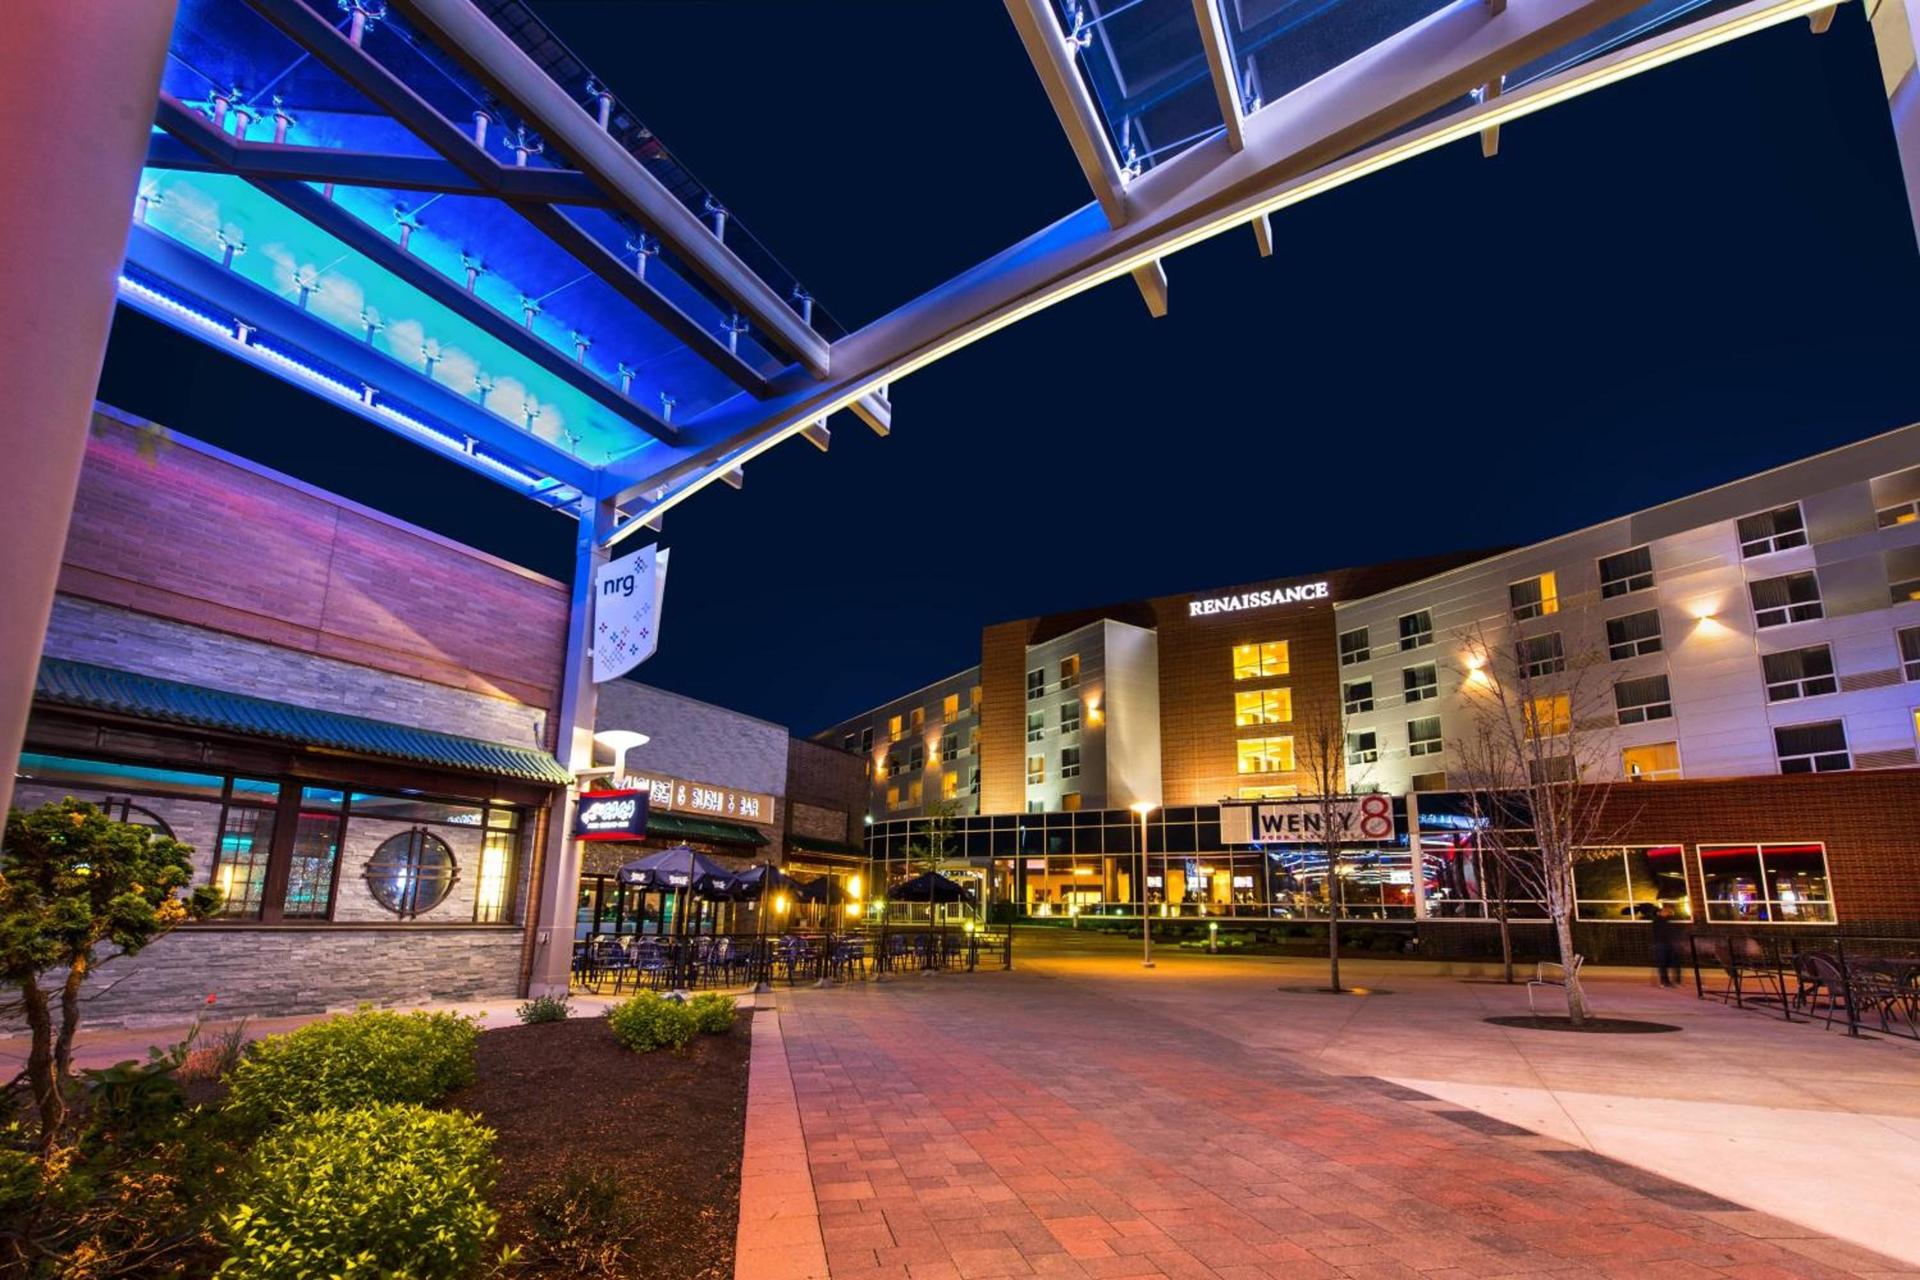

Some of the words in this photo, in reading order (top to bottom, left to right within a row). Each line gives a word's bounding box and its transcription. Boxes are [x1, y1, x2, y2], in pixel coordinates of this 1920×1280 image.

[603, 574, 635, 597] nrg
[1189, 581, 1329, 617] RENAISSANCE
[692, 787, 724, 812] SUSHI
